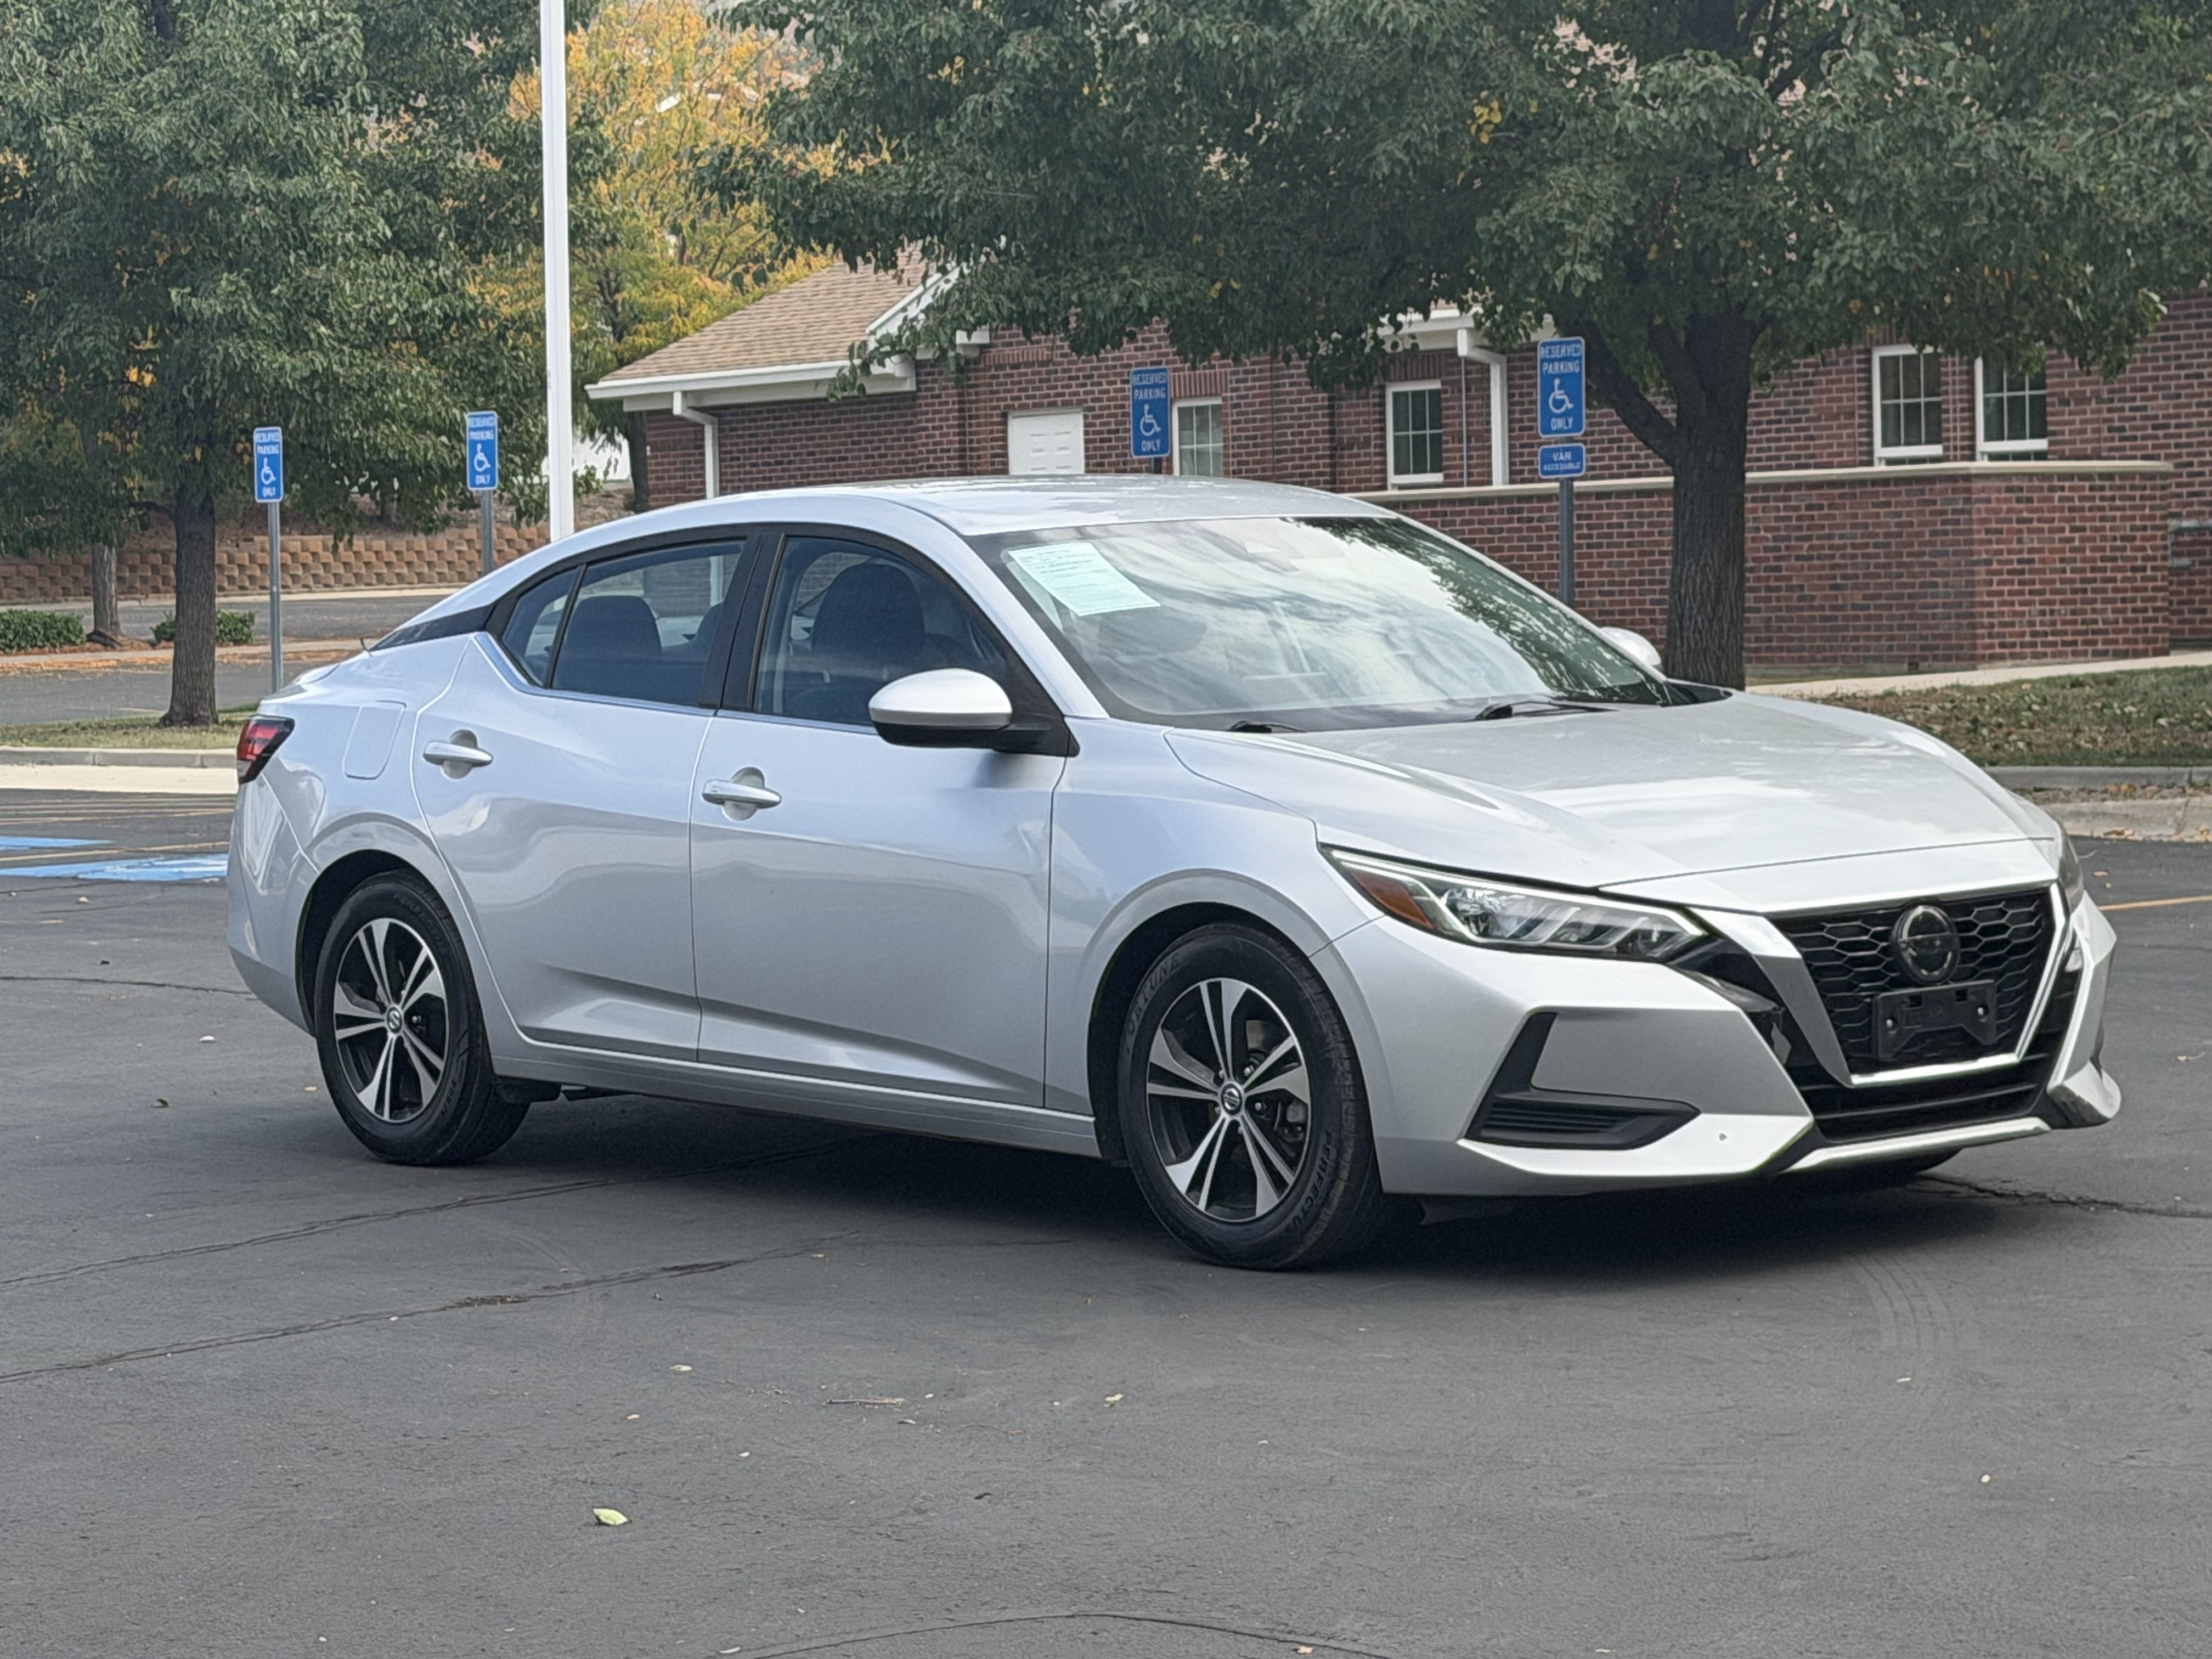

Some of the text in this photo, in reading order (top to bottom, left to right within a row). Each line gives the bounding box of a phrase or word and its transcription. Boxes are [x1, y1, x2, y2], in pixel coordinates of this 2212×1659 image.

[1540, 343, 1582, 358] RESERVED
[1543, 360, 1580, 374] PARKING
[1132, 372, 1167, 385] RESERVED
[1134, 387, 1166, 400] PARKING
[1550, 416, 1573, 431] ONLY
[1141, 439, 1161, 452] ONLY
[1552, 452, 1572, 462] VAN
